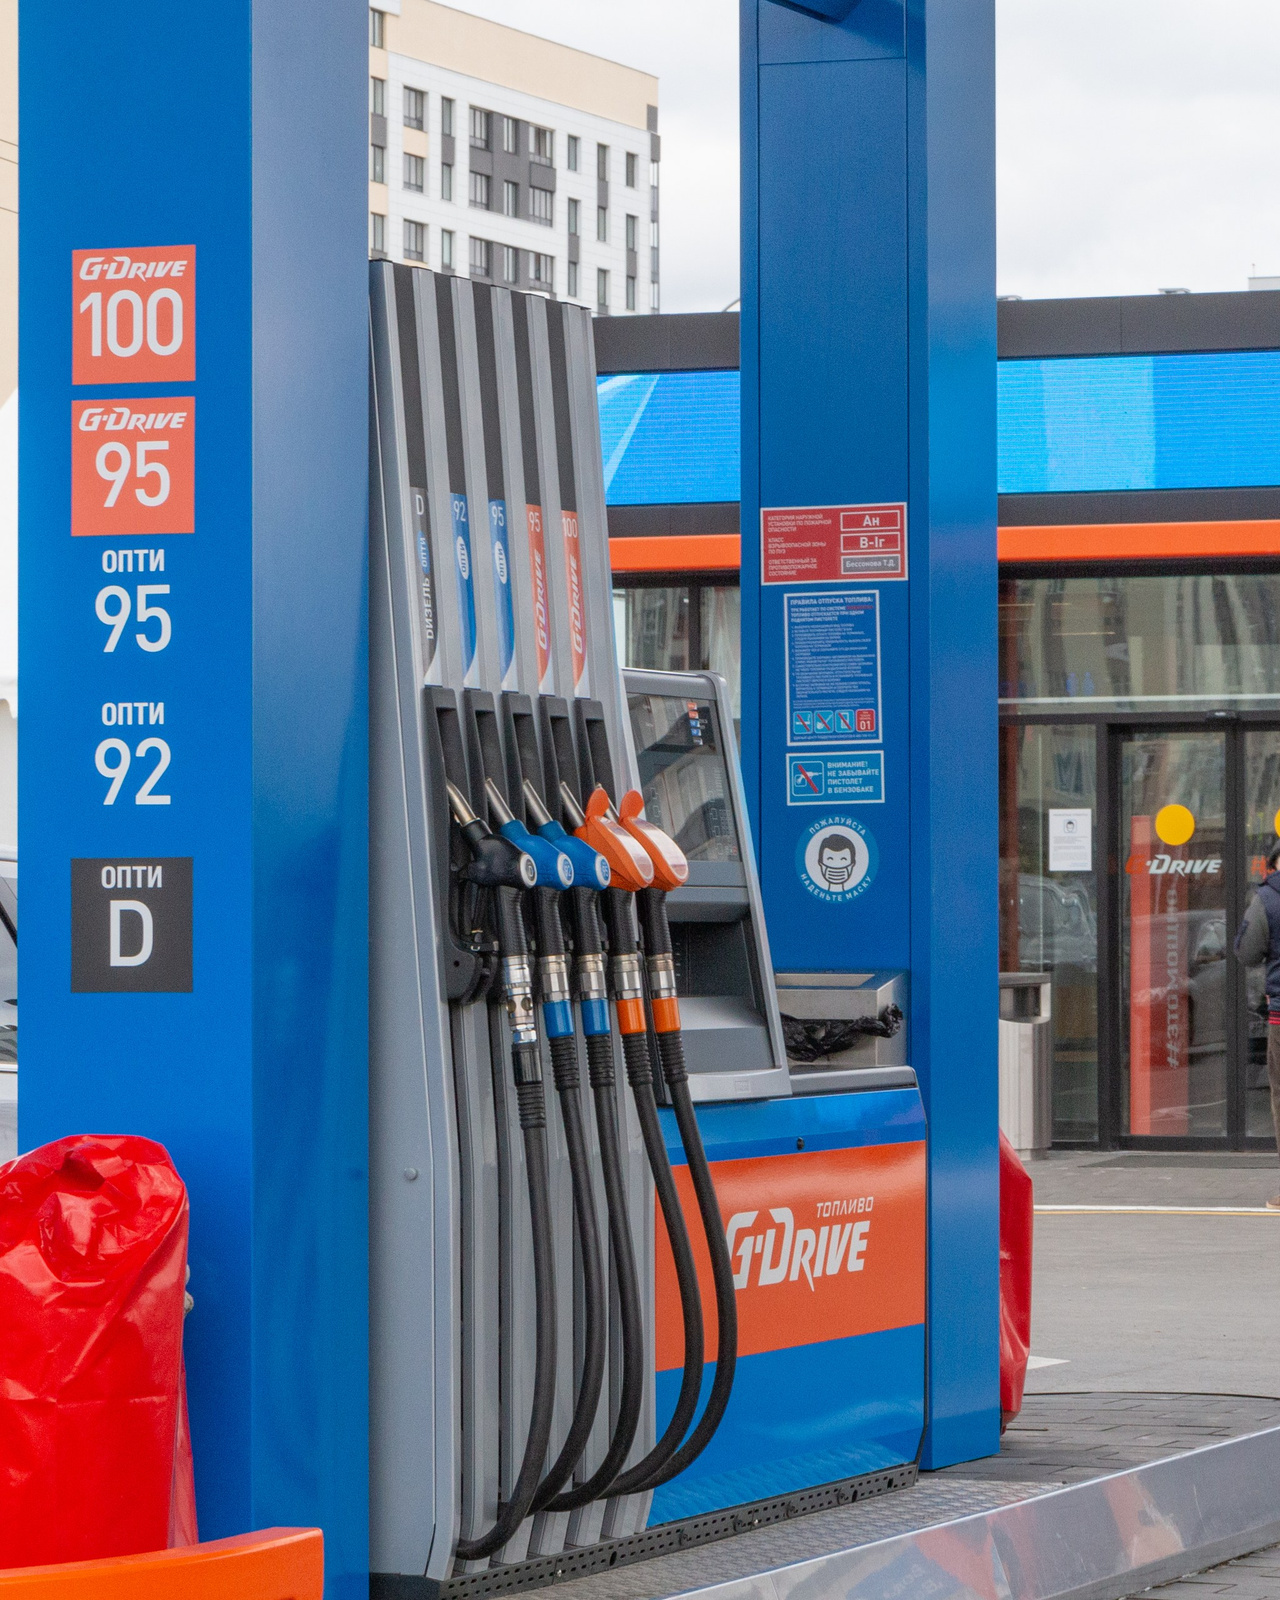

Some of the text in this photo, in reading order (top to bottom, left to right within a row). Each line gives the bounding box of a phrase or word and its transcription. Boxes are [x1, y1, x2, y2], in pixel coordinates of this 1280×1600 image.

[79, 288, 184, 358] 100
[95, 440, 171, 508] 95
[415, 494, 425, 515] D
[453, 501, 466, 522] 92
[491, 506, 504, 527] 95
[528, 512, 541, 533] 95
[863, 514, 880, 527] Ан
[562, 518, 578, 538] 100
[101, 549, 165, 574] ОПТИ
[94, 584, 172, 653] 95
[101, 702, 165, 726] ОПТИ
[860, 721, 871, 730] 01
[94, 737, 172, 806] 92
[827, 761, 868, 769] ВНИМАНИЕ!
[838, 768, 879, 776] ЗАБЫВАЙТЕ
[808, 816, 867, 836] ПОЖАЛУЙСТА
[101, 866, 163, 889] ОПТИ
[800, 873, 872, 902] НАДЕНЬТЕ МАСКУ
[109, 900, 154, 967] D
[816, 1196, 874, 1218] ТОПЛИВО
